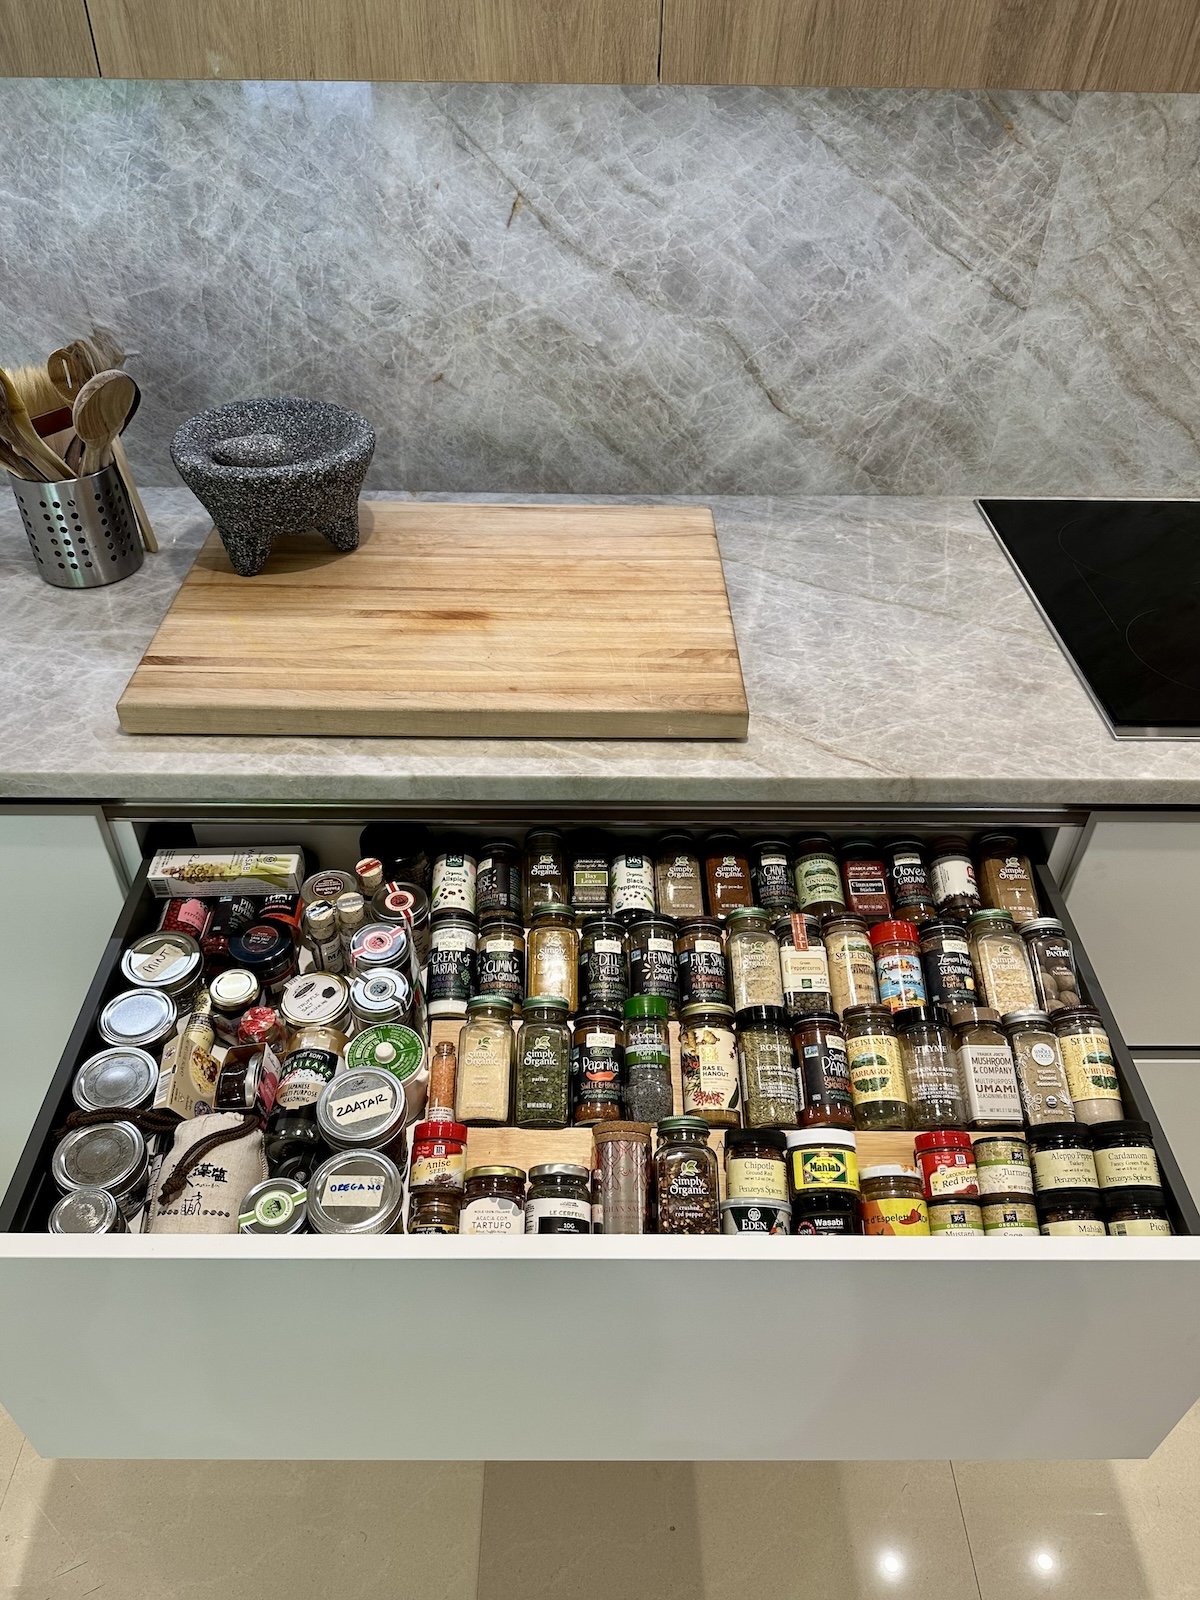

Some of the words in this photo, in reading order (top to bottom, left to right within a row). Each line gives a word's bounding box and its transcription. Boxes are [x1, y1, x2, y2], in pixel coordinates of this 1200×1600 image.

[668, 866, 694, 874] Simply
[716, 865, 742, 873] Simply
[763, 865, 787, 877] CHIVE
[892, 866, 926, 878] Cloves
[897, 876, 926, 885] GROUND
[431, 951, 462, 964] CREAM
[1046, 949, 1070, 957] PANTRY
[142, 948, 169, 973] MINT
[598, 953, 619, 966] DILL
[690, 953, 710, 968] FIVE
[432, 962, 459, 975] TARTAR
[486, 960, 513, 973] CUMIN
[599, 966, 619, 975] WEED
[654, 964, 672, 974] Seed
[630, 1031, 663, 1041] McCormick
[915, 1045, 948, 1054] THYME
[468, 1050, 496, 1060] Simply
[526, 1050, 556, 1062] Simply
[582, 1057, 619, 1072] Paprika
[971, 1056, 1011, 1066] MUSHROOM
[702, 1070, 729, 1078] HANOUT
[851, 1069, 893, 1080] TARRAGON
[973, 1066, 978, 1074] &
[980, 1066, 1012, 1074] COMPANY
[975, 1084, 1017, 1094] UMAMI
[1051, 1151, 1075, 1161] Aleppo
[1108, 1151, 1148, 1160] Cardamom
[426, 1160, 451, 1170] Anise
[744, 1161, 775, 1171] Chipotle
[810, 1162, 841, 1172] Mahlab
[429, 1167, 447, 1175] SEED
[672, 1176, 705, 1188] Simply
[1054, 1176, 1081, 1185] Penzeys
[1105, 1174, 1132, 1183] Penzeys
[1133, 1172, 1153, 1181] Spices
[330, 1183, 381, 1193] OREGANO
[942, 1179, 959, 1188] Red
[739, 1185, 764, 1194] Penzeys
[765, 1185, 783, 1194] Spices
[953, 1214, 964, 1222] 365
[1004, 1213, 1016, 1221] 365
[742, 1219, 768, 1230] EDEN
[814, 1218, 844, 1227] Wasabi
